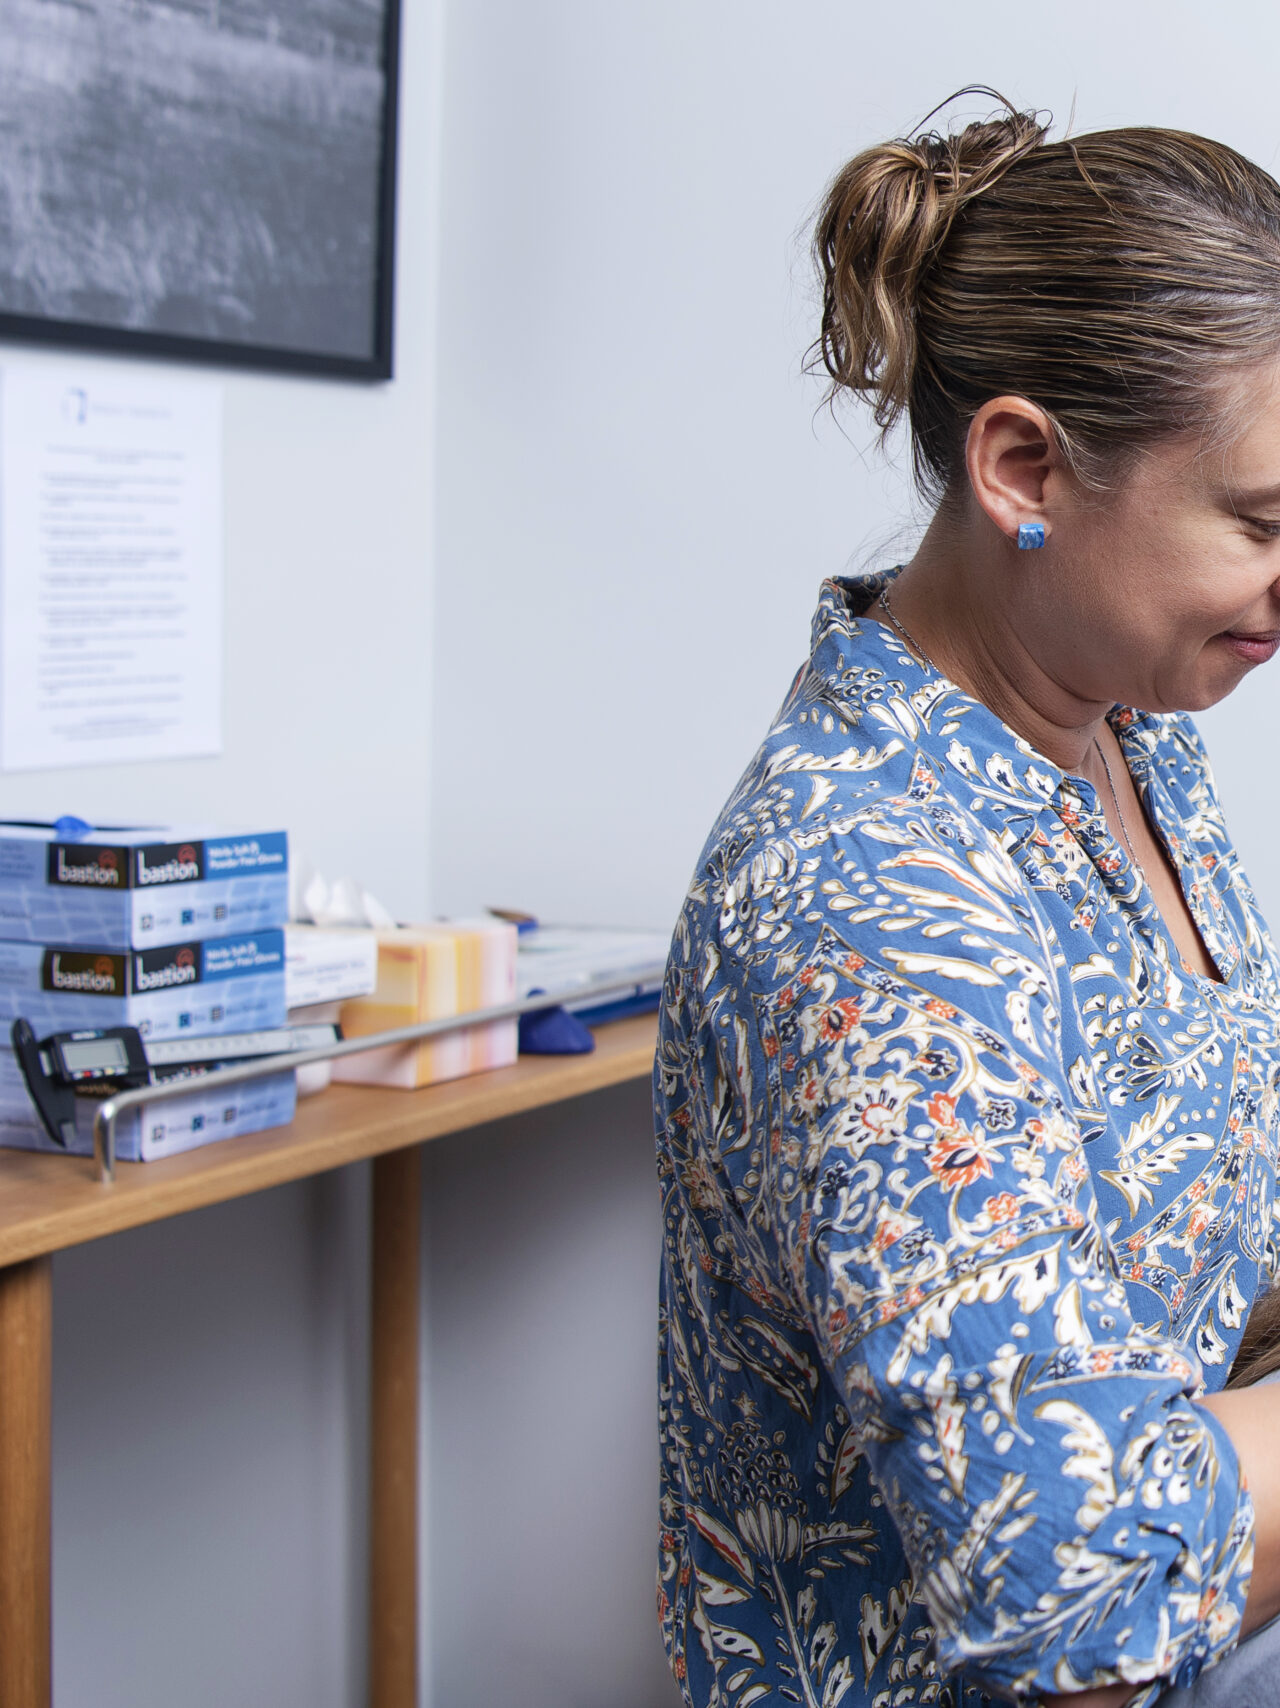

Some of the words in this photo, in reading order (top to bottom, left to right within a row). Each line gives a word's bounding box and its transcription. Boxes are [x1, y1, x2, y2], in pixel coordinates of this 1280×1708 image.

[58, 847, 119, 884] bastion
[138, 850, 199, 884] bastion
[52, 953, 116, 991] bastion
[136, 955, 196, 990] bastion
